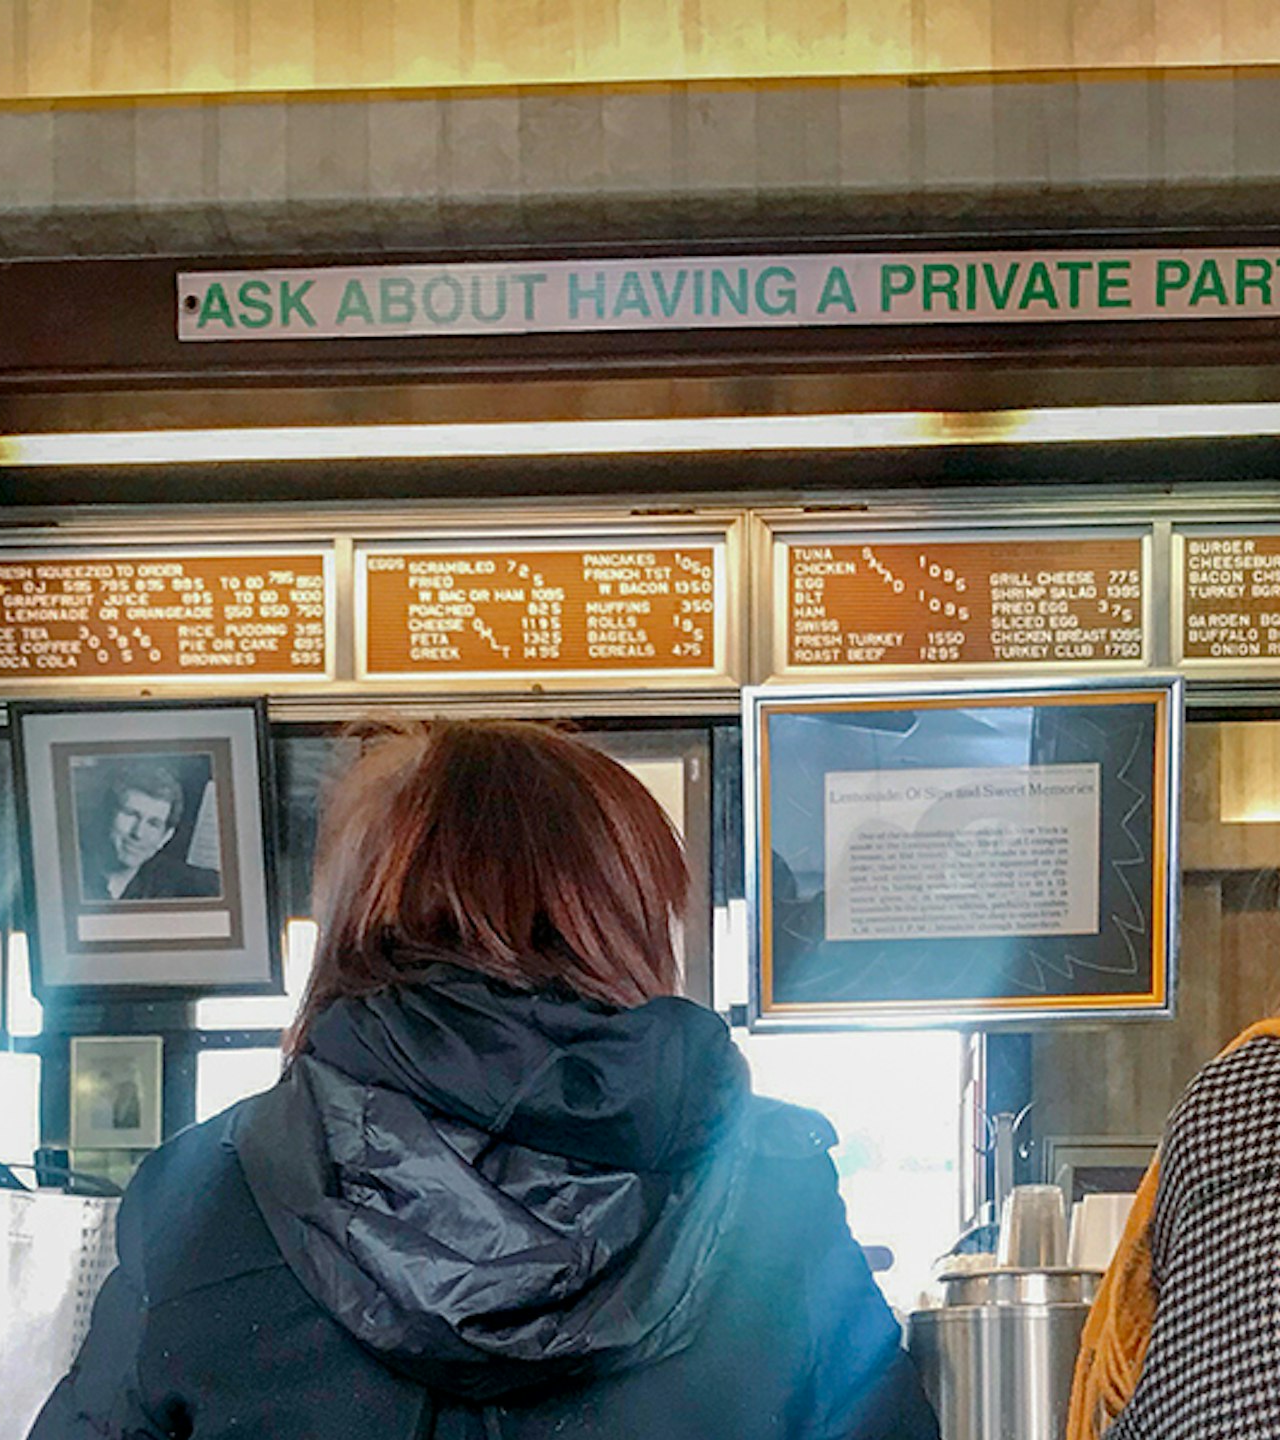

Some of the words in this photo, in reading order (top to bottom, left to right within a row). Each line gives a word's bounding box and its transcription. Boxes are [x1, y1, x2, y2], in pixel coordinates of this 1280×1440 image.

[197, 282, 315, 331] ASK
[336, 275, 548, 327] ABOUT
[567, 267, 798, 321] HAVING
[819, 265, 860, 312] A
[880, 261, 1131, 311] PRIVATE
[1189, 541, 1254, 554] BURGER
[583, 554, 655, 566] PANCAKES
[794, 549, 832, 561] TUNA
[37, 566, 112, 578] SQUEEZED
[116, 565, 133, 577] TO
[138, 564, 182, 577] ORDER
[409, 561, 494, 574] SCRAMBLED
[584, 568, 640, 581] FRENCH
[645, 567, 671, 579] TST
[794, 562, 856, 575] CHICKEN
[409, 576, 453, 589] FRIED
[795, 578, 824, 589] EGG
[990, 572, 1031, 586] GRILL
[1038, 571, 1094, 584] CHEESE
[1189, 570, 1242, 584] BACON
[23, 582, 45, 592] OJ
[221, 578, 239, 589] TO
[620, 582, 668, 594] BACON
[1189, 585, 1245, 598] TURKEY
[1251, 584, 1280, 597] BGR
[4, 594, 94, 607] GRAPEFRUIT
[104, 592, 149, 606] JUICE
[234, 592, 253, 604] TO
[470, 590, 489, 601] OR
[494, 589, 524, 601] HAM
[795, 591, 824, 604] BLT
[991, 588, 1046, 600] SHRIMP
[1050, 586, 1096, 599] SALAD
[6, 608, 89, 621] LEMONADE
[100, 608, 119, 619] OR
[127, 606, 212, 620] ORANGEADE
[409, 604, 474, 617] POACHED
[586, 601, 651, 614] MUFFINS
[682, 601, 712, 613] 350
[795, 606, 826, 618] HAM
[992, 602, 1035, 614] FRIED
[1039, 601, 1068, 614] EGG
[409, 619, 464, 631] CHEESE
[587, 616, 637, 629] ROLLS
[795, 619, 839, 632] SWISS
[991, 617, 1044, 629] SLICED
[1049, 615, 1078, 627] EGG
[1188, 614, 1249, 628] GARDEN
[22, 628, 48, 639] TEA
[178, 625, 214, 637] RICE
[226, 625, 287, 636] PUDDING
[587, 631, 646, 644] BAGELS
[991, 631, 1053, 644] CHICKEN
[1056, 629, 1106, 642] BREAST
[1188, 628, 1258, 642] BUFFALO
[179, 639, 205, 651] PIE
[212, 638, 231, 650] OR
[236, 638, 278, 651] CAKE
[411, 633, 449, 646] FETA
[795, 634, 842, 648] FRESH
[848, 633, 904, 646] TURKEY
[21, 641, 81, 653] COFFEE
[589, 645, 654, 658] CEREALS
[992, 646, 1048, 658] TURKEY
[1055, 644, 1094, 657] CLUB
[1211, 642, 1259, 656] ONION
[179, 653, 254, 666] BROWNIES
[409, 648, 460, 661] GREEK
[794, 648, 839, 661] ROAST
[37, 656, 77, 668] COLA
[984, 785, 1025, 796] Sweet
[1029, 784, 1093, 796] Memories
